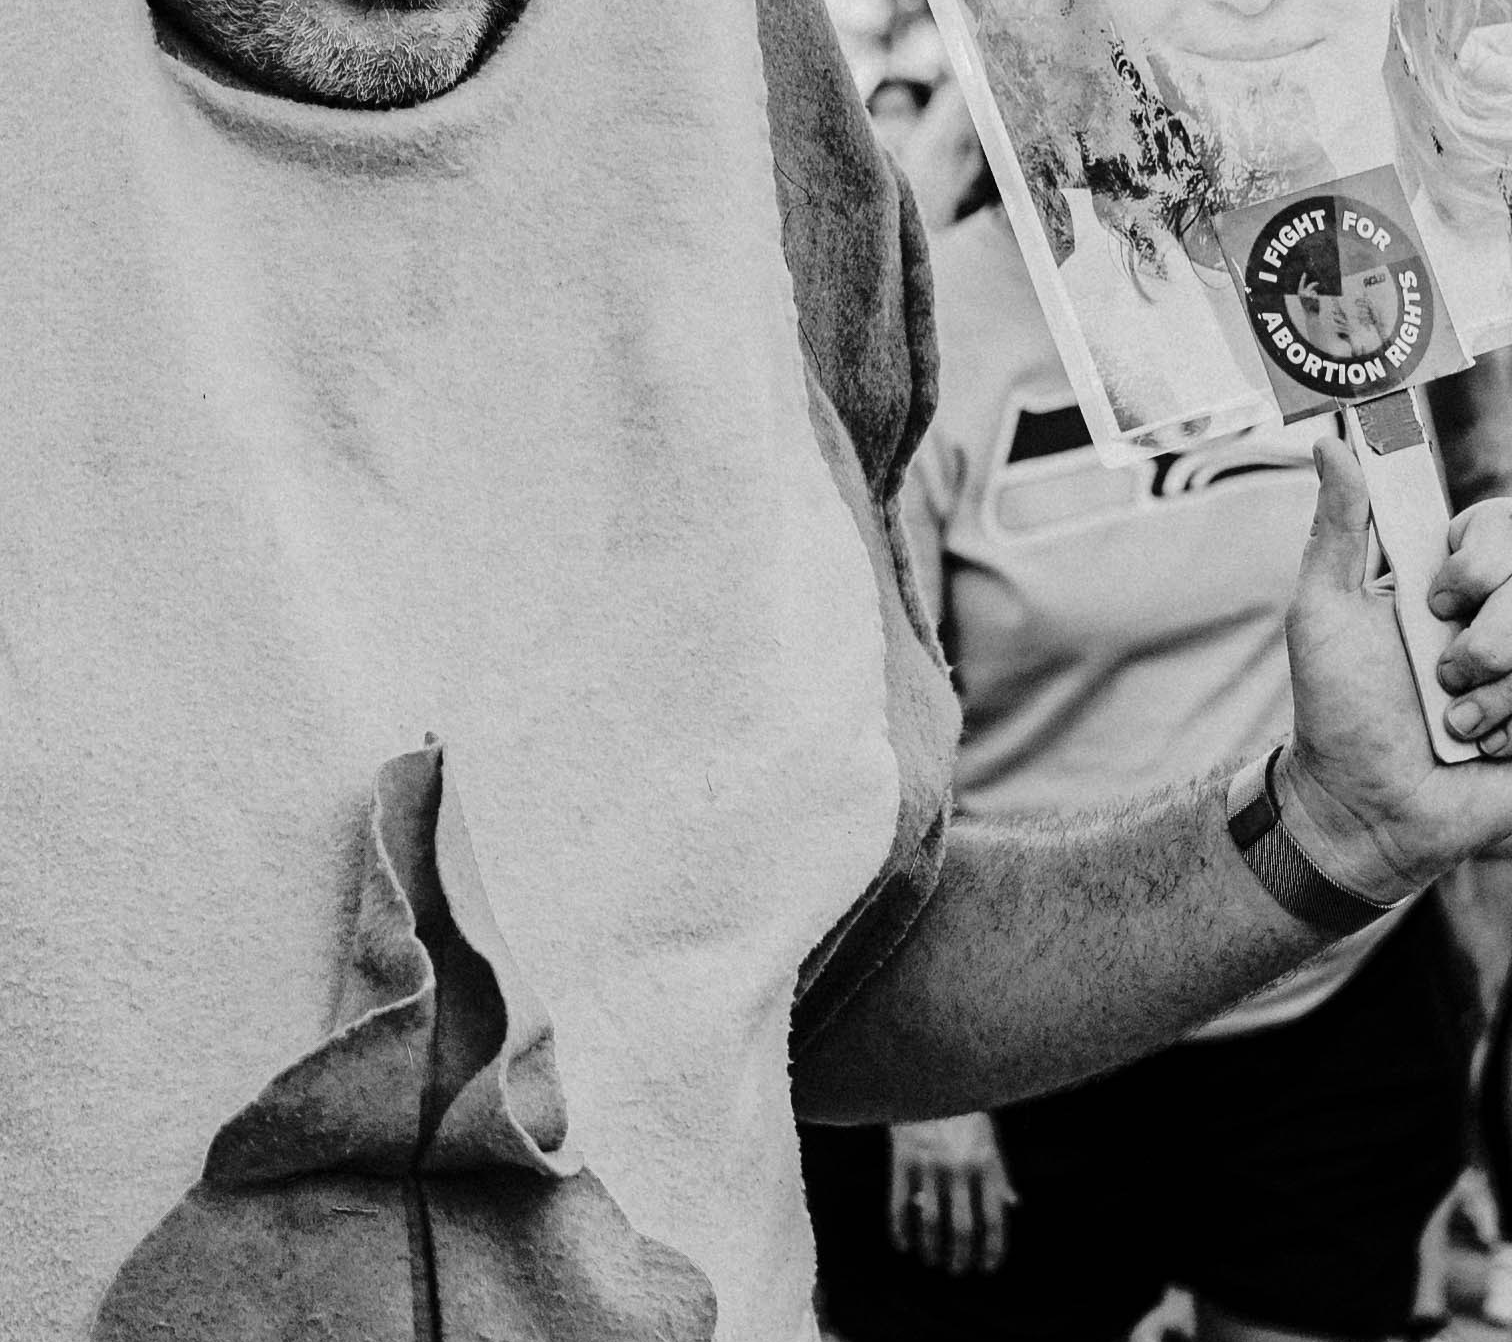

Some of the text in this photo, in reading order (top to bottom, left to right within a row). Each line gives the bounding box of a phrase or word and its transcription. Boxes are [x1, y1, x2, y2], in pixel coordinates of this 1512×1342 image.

[1258, 209, 1392, 284] I FIGHT FOR
[1261, 269, 1422, 385] ABORTION RIGHTS
